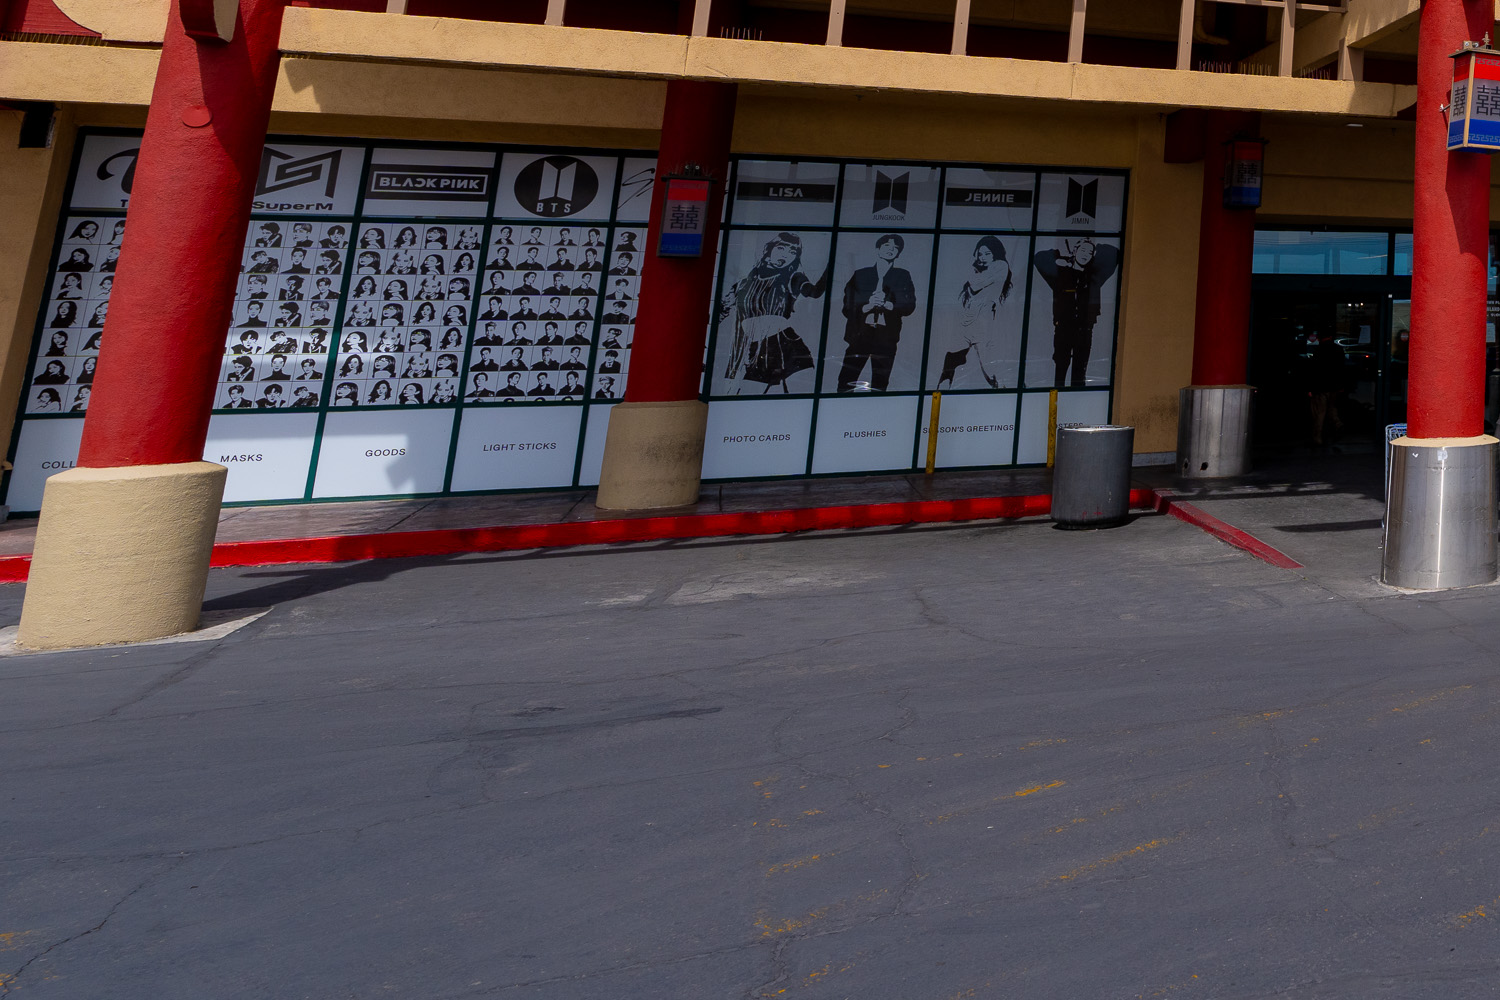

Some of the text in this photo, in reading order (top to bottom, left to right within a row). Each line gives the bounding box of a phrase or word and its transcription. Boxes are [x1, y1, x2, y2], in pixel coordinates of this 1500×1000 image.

[768, 187, 803, 197] LISA
[965, 193, 1015, 203] JENNIE
[252, 201, 333, 212] SuperM
[536, 203, 571, 213] BTS
[1071, 217, 1090, 225] JIMIN
[843, 429, 887, 438] PLUSHIES
[966, 424, 1014, 433] GREETINGS
[723, 433, 791, 443] PHOTO CARDS
[483, 442, 557, 452] LIGHT STICKS
[365, 448, 406, 457] GOODS
[220, 453, 263, 463] MASKS
